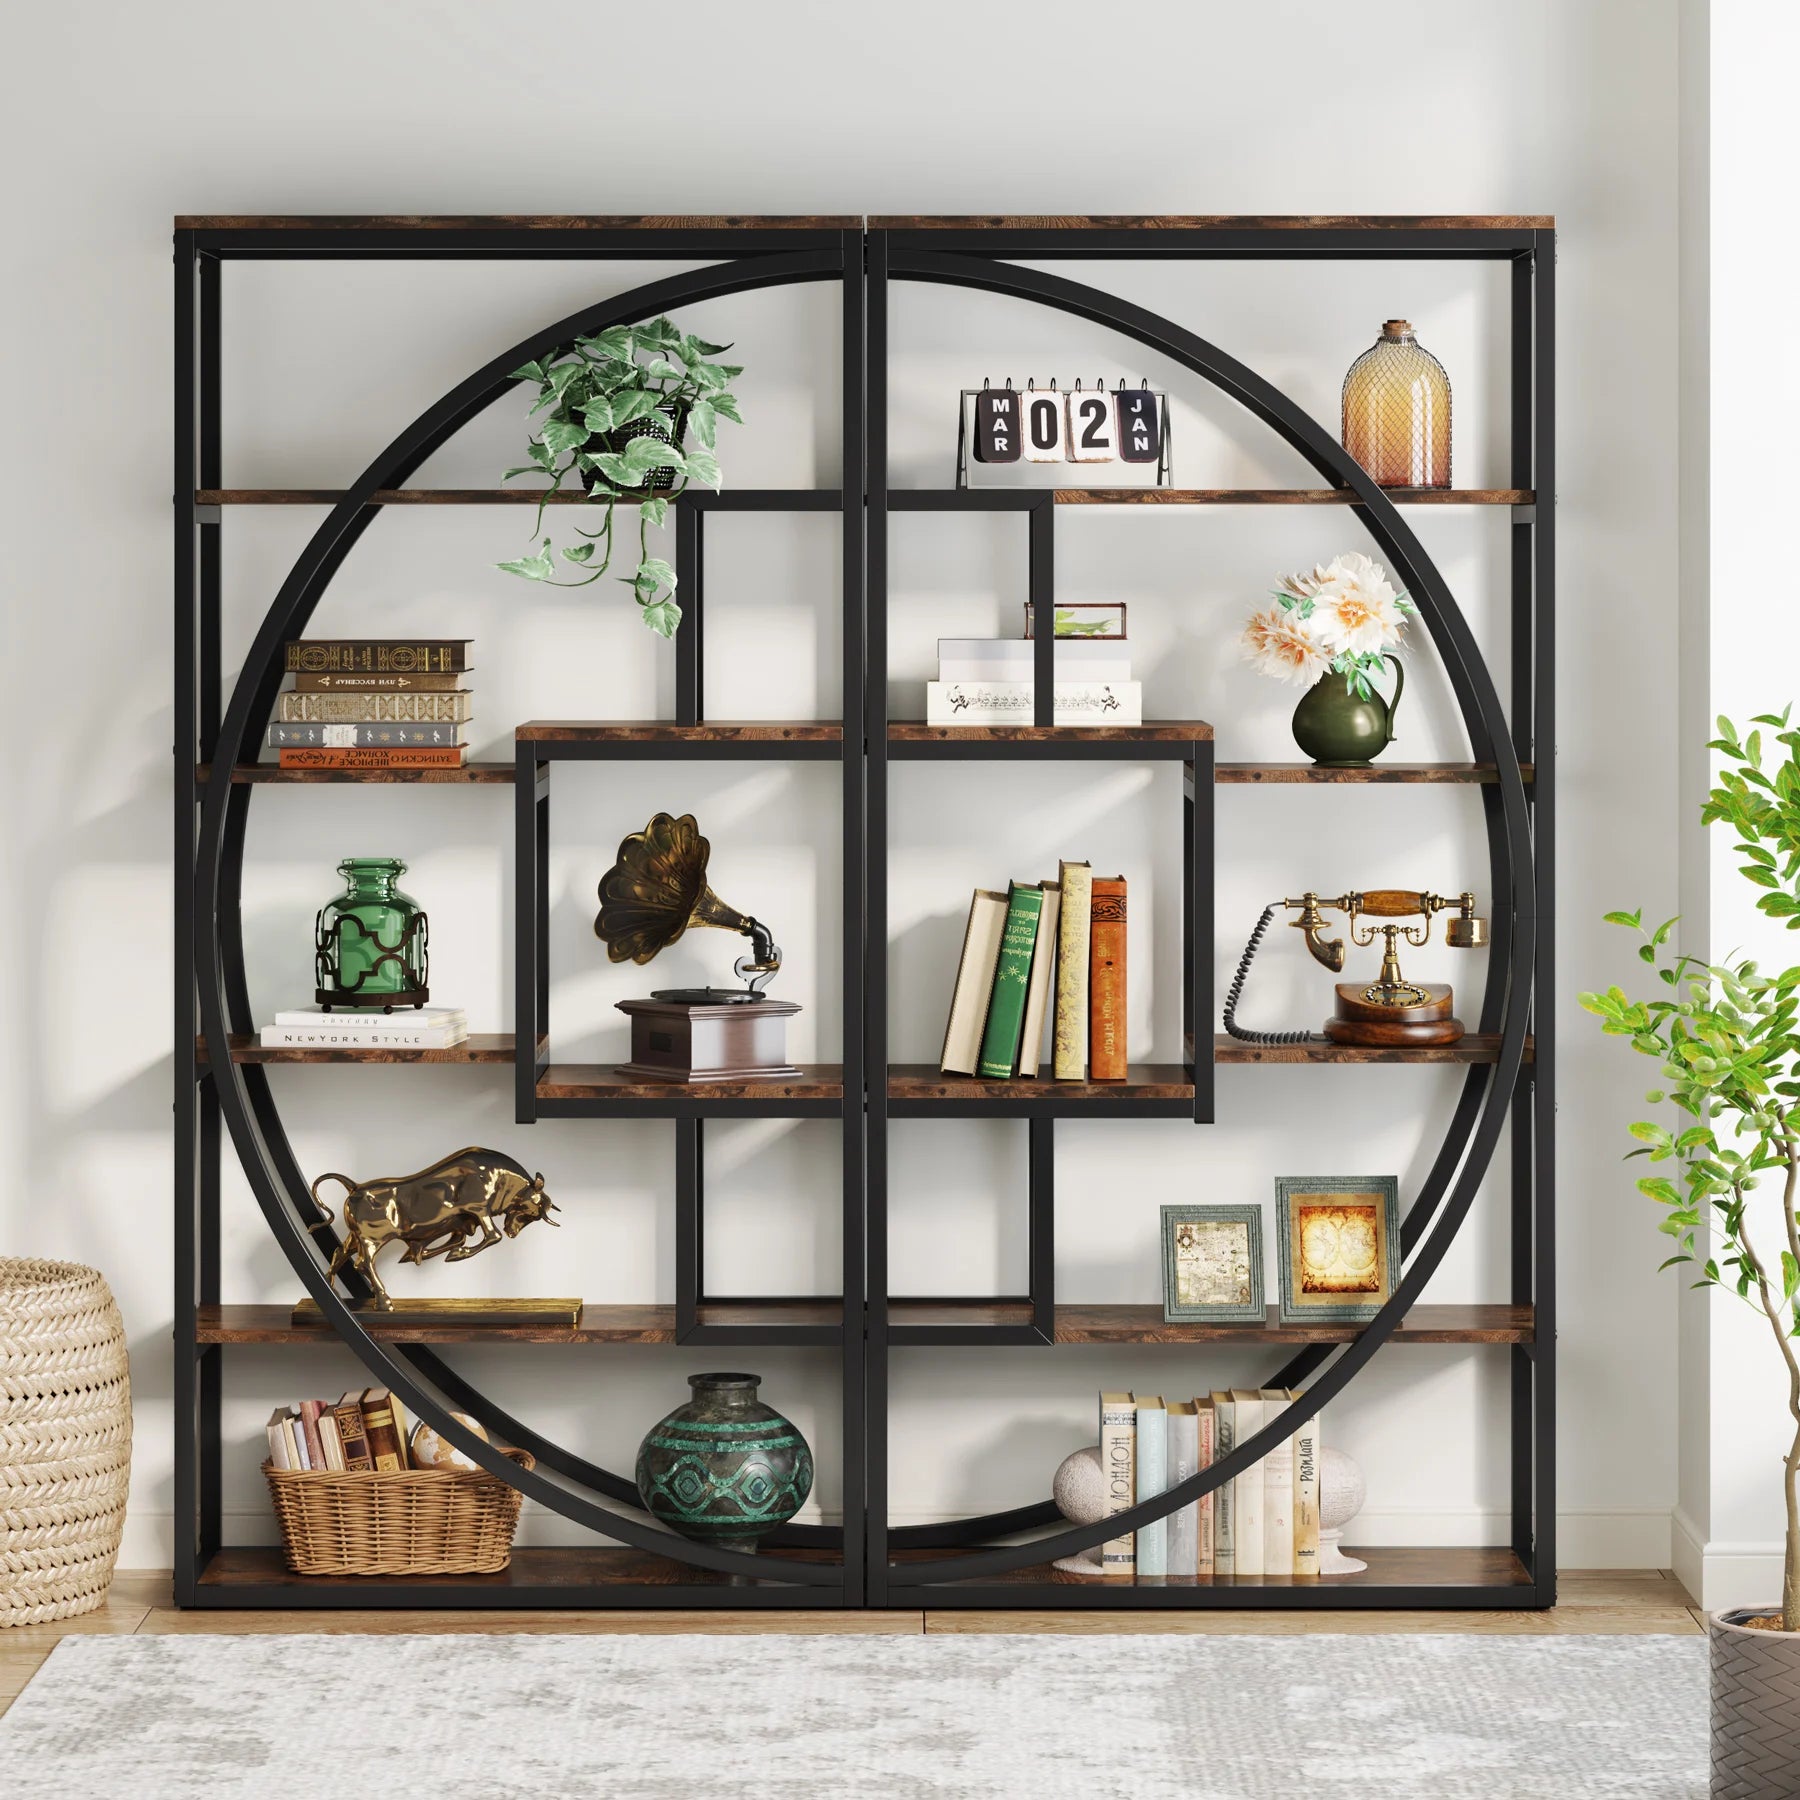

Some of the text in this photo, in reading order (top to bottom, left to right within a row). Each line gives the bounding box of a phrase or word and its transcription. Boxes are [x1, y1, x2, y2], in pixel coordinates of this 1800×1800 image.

[992, 398, 1010, 452] MAR
[1130, 398, 1149, 452] JAN
[339, 758, 390, 767] ШЕРЛОКЕ
[345, 750, 390, 758] ХОЛМСЕ
[391, 754, 452, 764] ЗАПИСКИ О
[1110, 1437, 1130, 1502] ЛОНДОН
